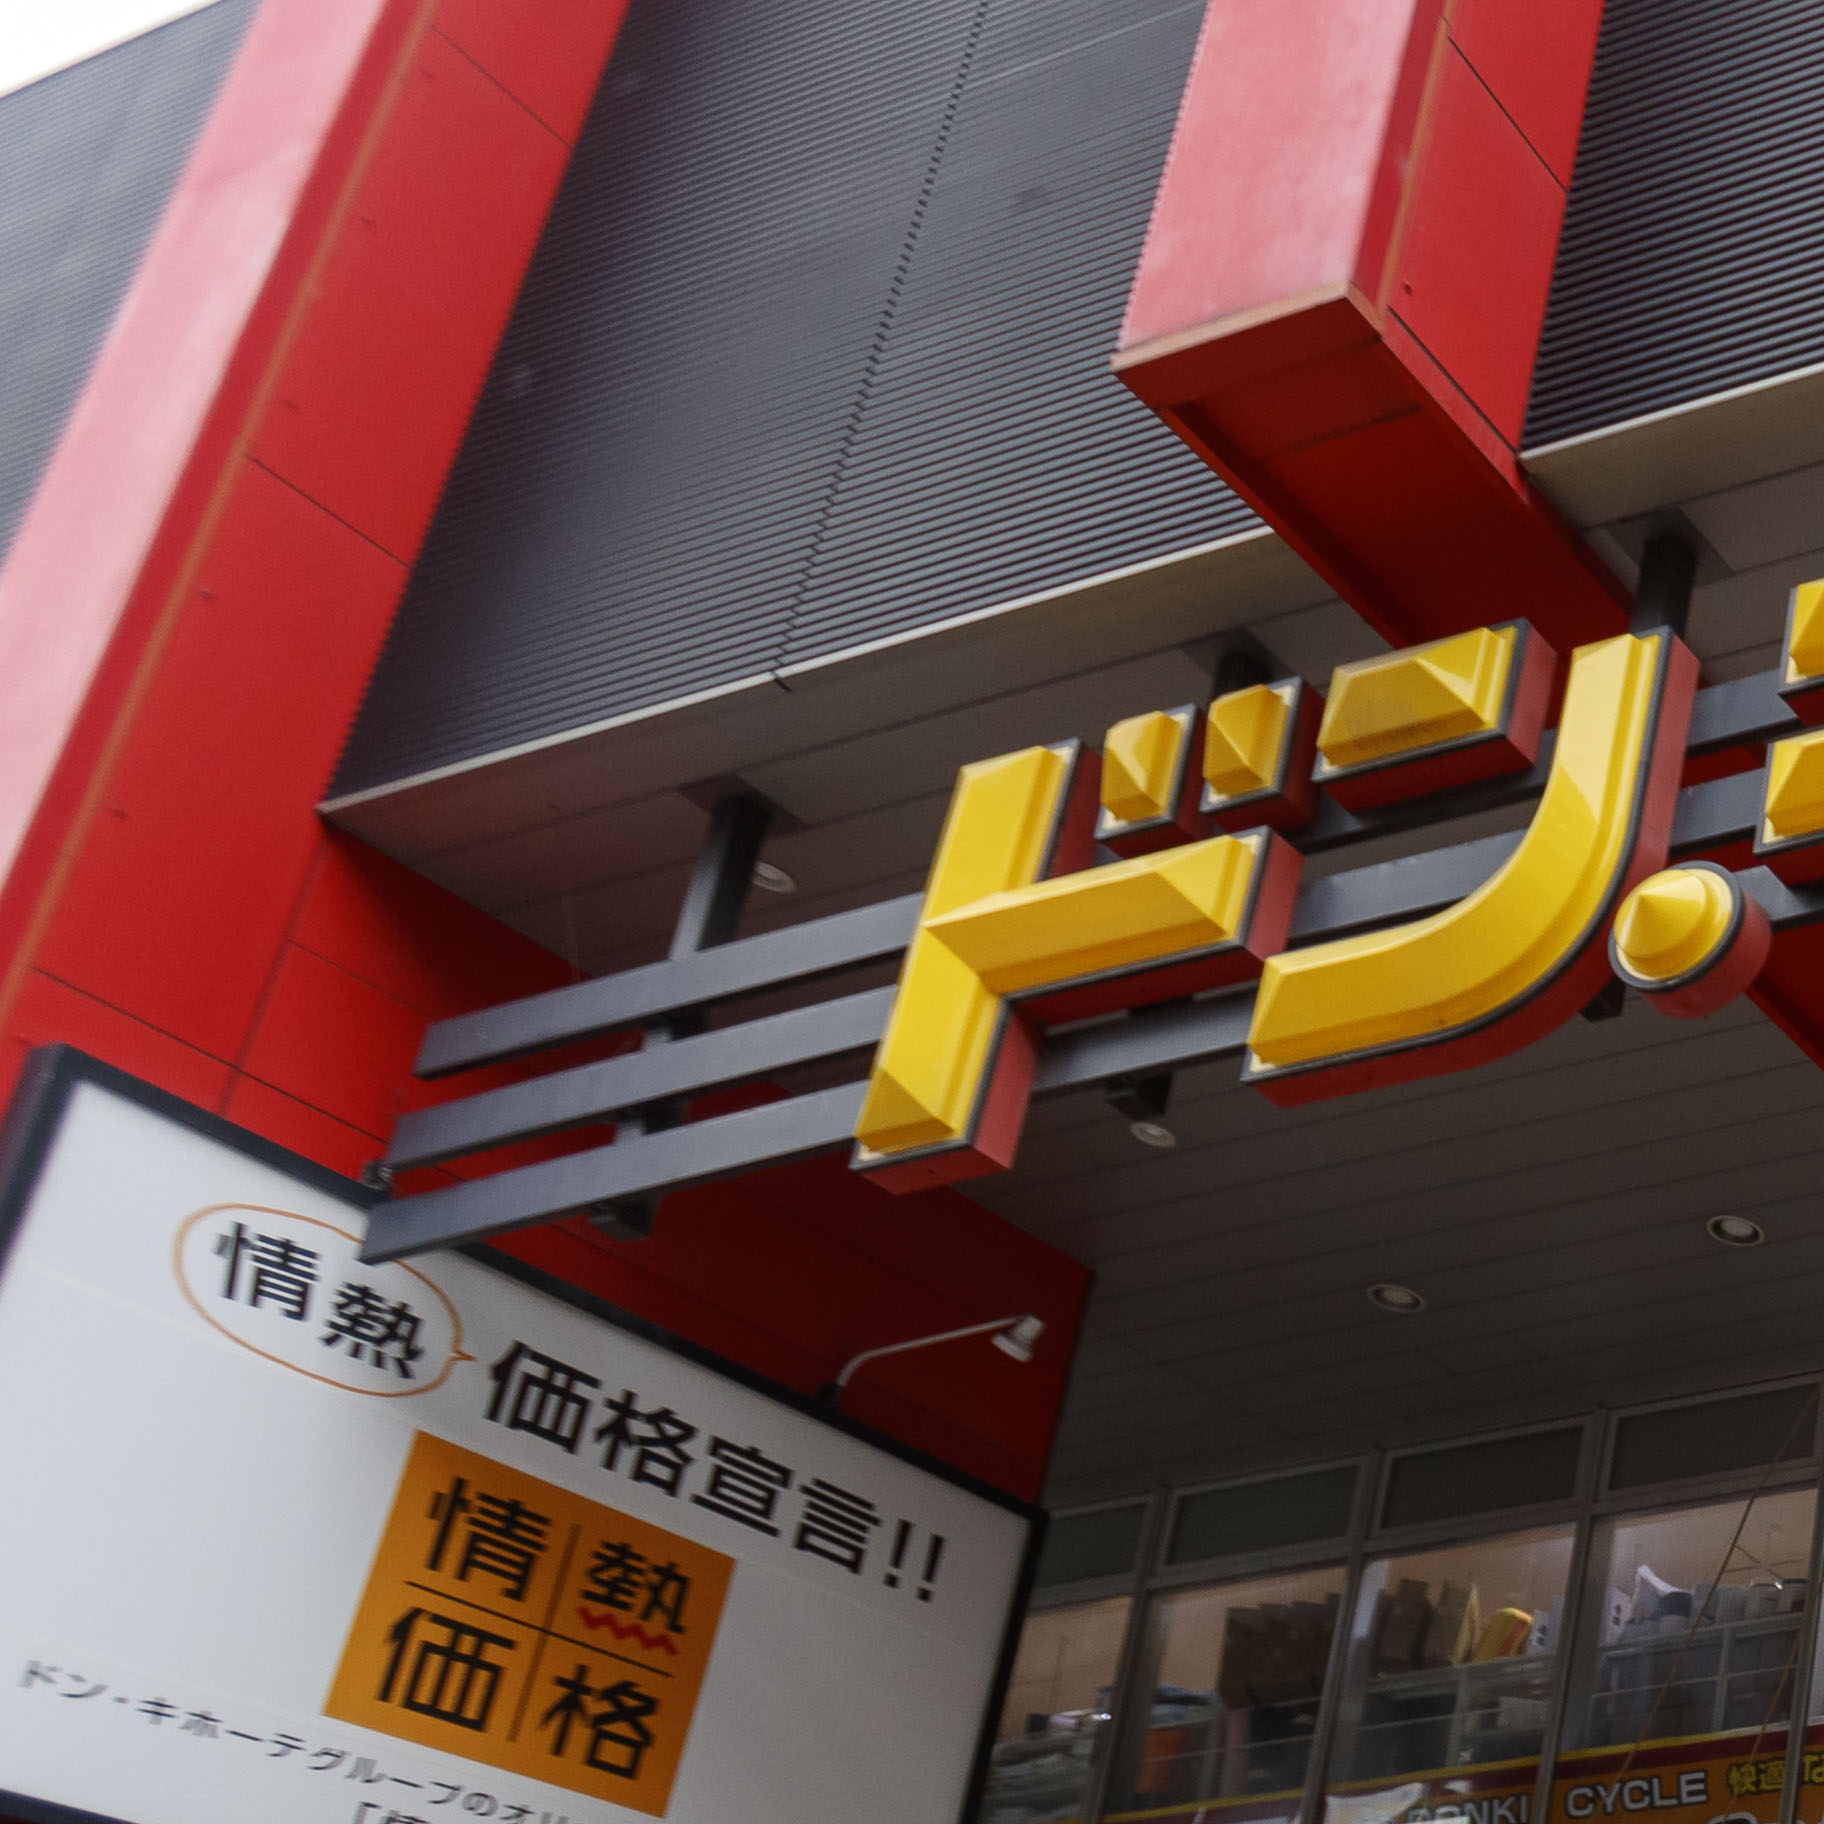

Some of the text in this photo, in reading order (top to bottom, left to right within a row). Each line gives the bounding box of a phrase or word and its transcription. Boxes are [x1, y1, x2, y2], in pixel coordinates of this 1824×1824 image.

[213, 1219, 427, 1380] 情熱
[488, 1338, 947, 1601] 価格宣言!!
[427, 1475, 692, 1636] 情熱
[376, 1606, 662, 1782] 価格
[1567, 1771, 1707, 1819] CYCLE
